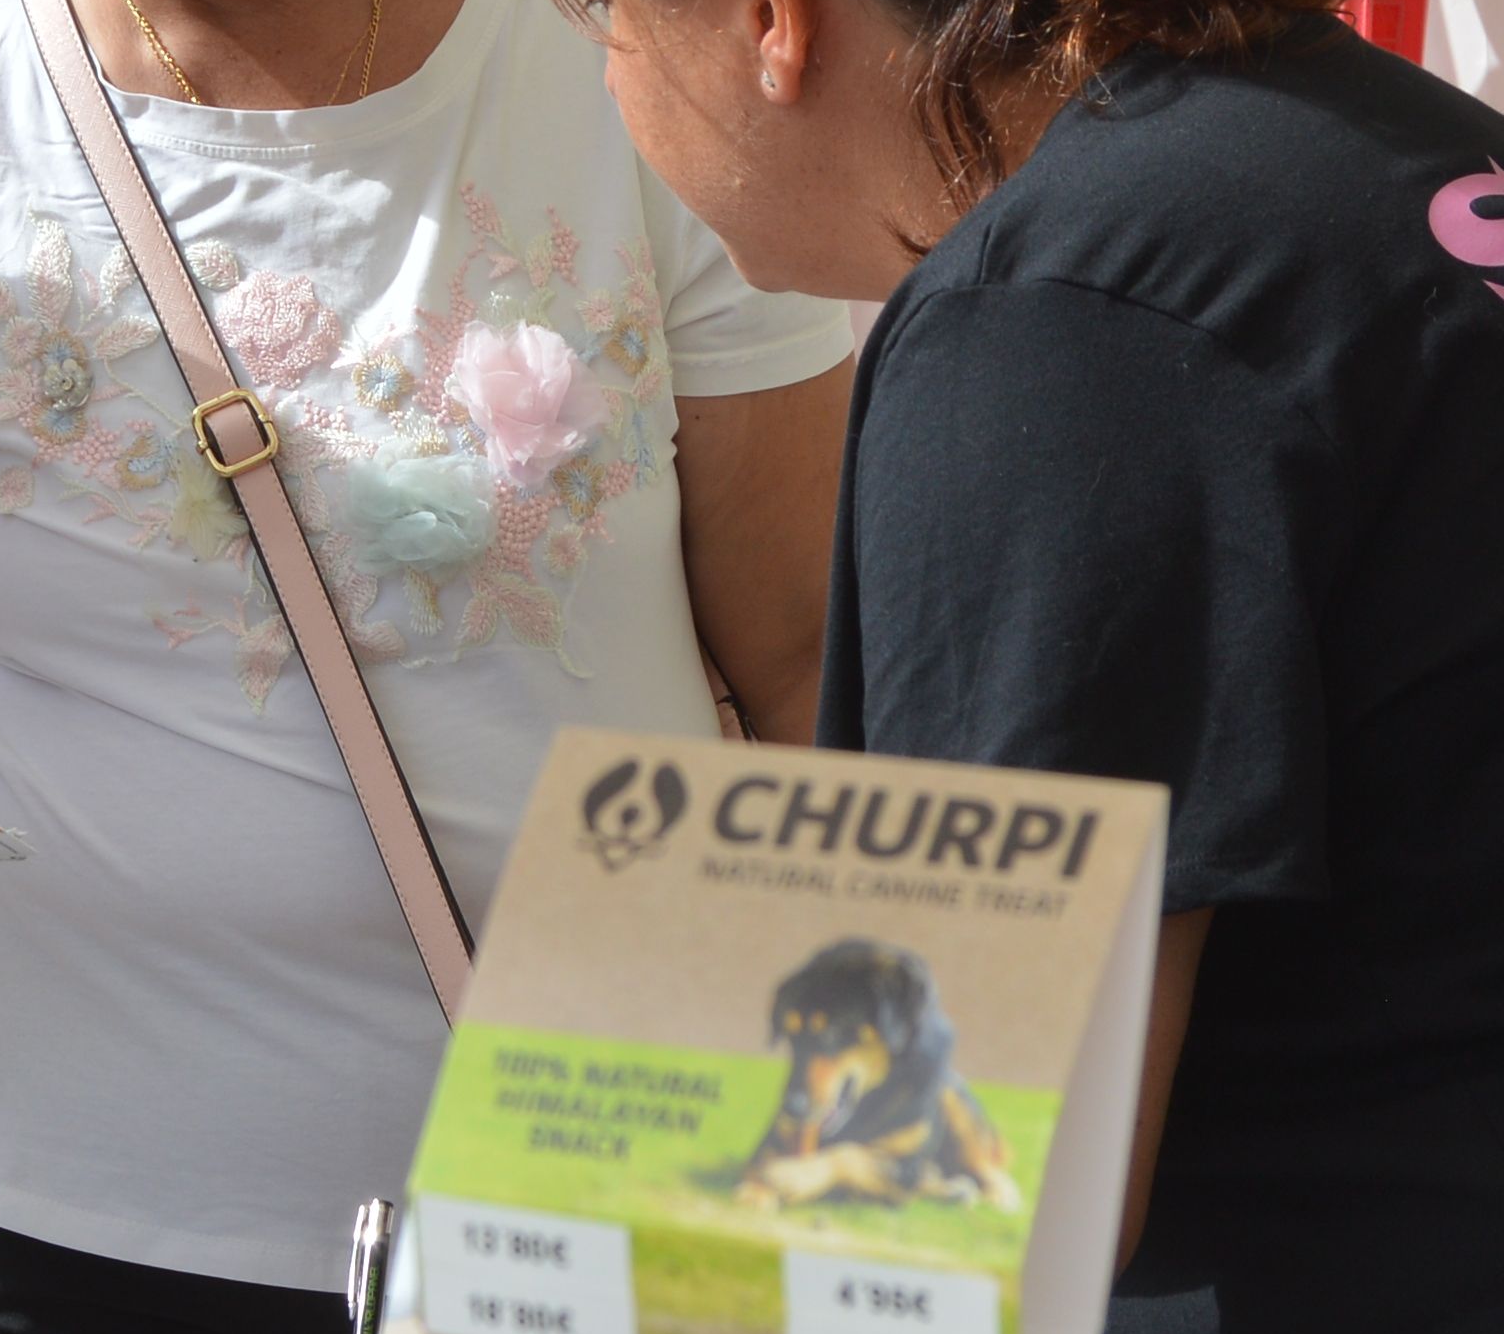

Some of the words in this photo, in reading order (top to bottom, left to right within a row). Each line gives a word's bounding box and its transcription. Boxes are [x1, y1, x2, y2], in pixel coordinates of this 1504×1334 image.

[710, 770, 1104, 881] CHURPI
[701, 853, 839, 901] NATURAL
[848, 872, 962, 912] CANINE
[975, 883, 1070, 920] TREAT
[494, 1045, 571, 1085] 100%
[578, 1058, 725, 1106] NATURAL
[494, 1082, 704, 1138] HIMALAYAN
[527, 1123, 632, 1165] SNACK
